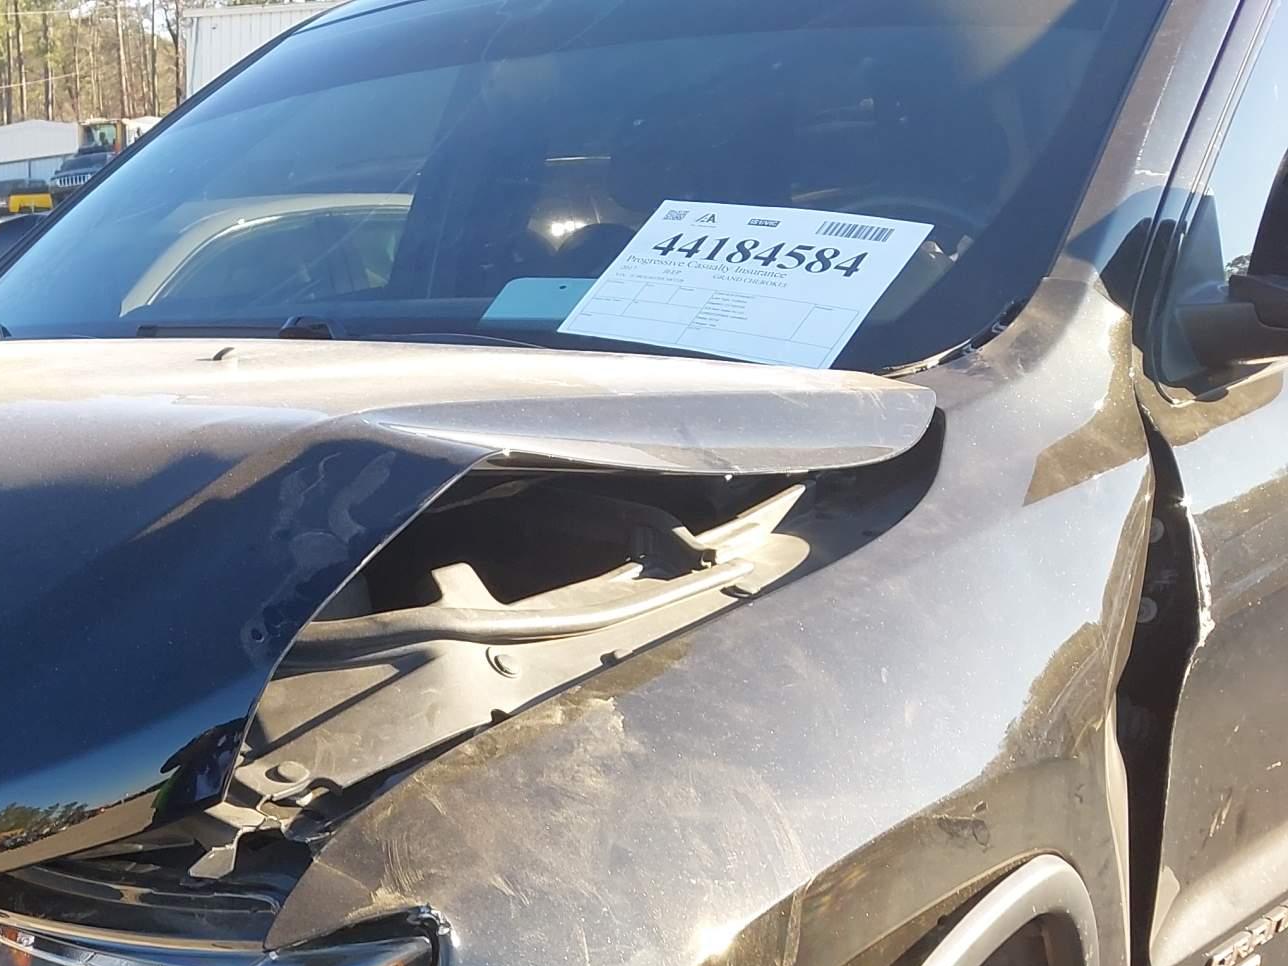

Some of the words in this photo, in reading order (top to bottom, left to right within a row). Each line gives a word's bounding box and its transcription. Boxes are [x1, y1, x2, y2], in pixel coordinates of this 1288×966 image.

[626, 254, 687, 268] Progressive
[687, 260, 730, 273] Casualty
[734, 265, 788, 279] Insurance
[652, 233, 869, 278] 44184584
